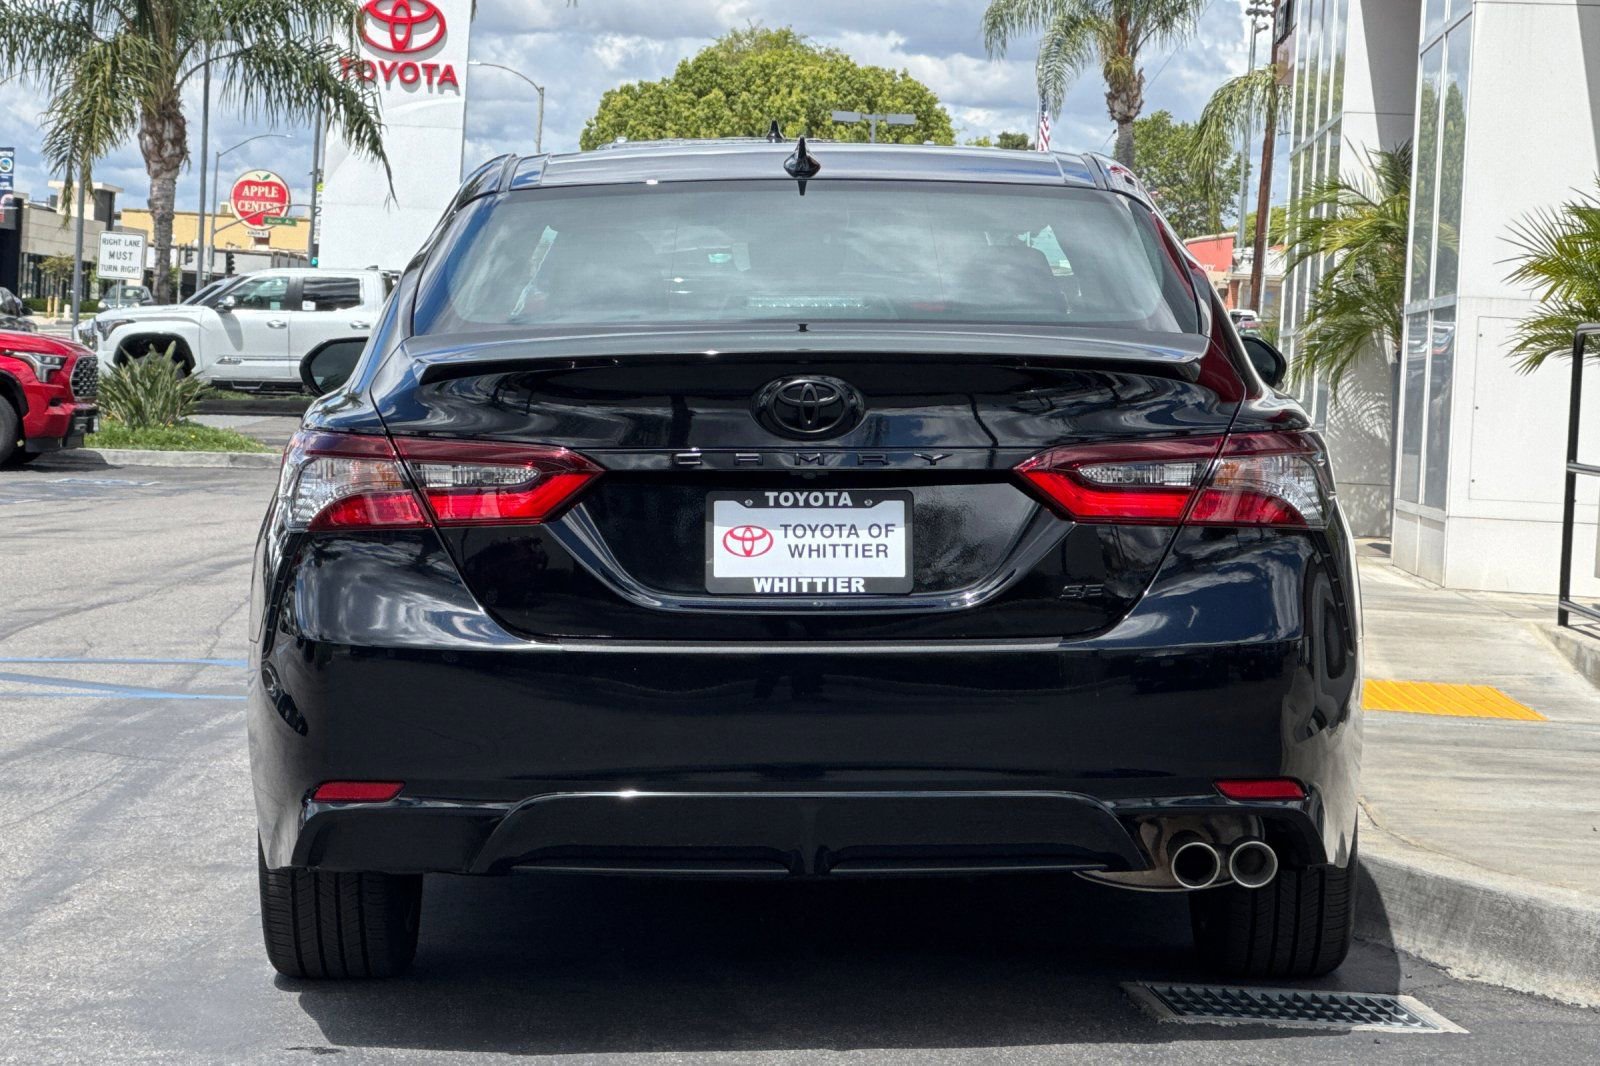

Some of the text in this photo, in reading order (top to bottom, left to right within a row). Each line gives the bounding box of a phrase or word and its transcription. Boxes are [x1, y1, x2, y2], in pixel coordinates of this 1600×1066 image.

[338, 57, 459, 88] TOYOTA
[242, 185, 279, 198] APPLE
[237, 200, 281, 214] CENTER
[102, 238, 141, 248] RIGHT LANE
[108, 250, 133, 261] MUST
[100, 263, 140, 274] TURN RIGHT
[672, 452, 953, 466] CAMRY
[765, 491, 853, 507] TOYOTA
[779, 523, 897, 539] TOYOTA OF
[787, 543, 890, 559] WHITTIER
[753, 577, 866, 593] WHITTIER
[1059, 584, 1104, 599] SE
